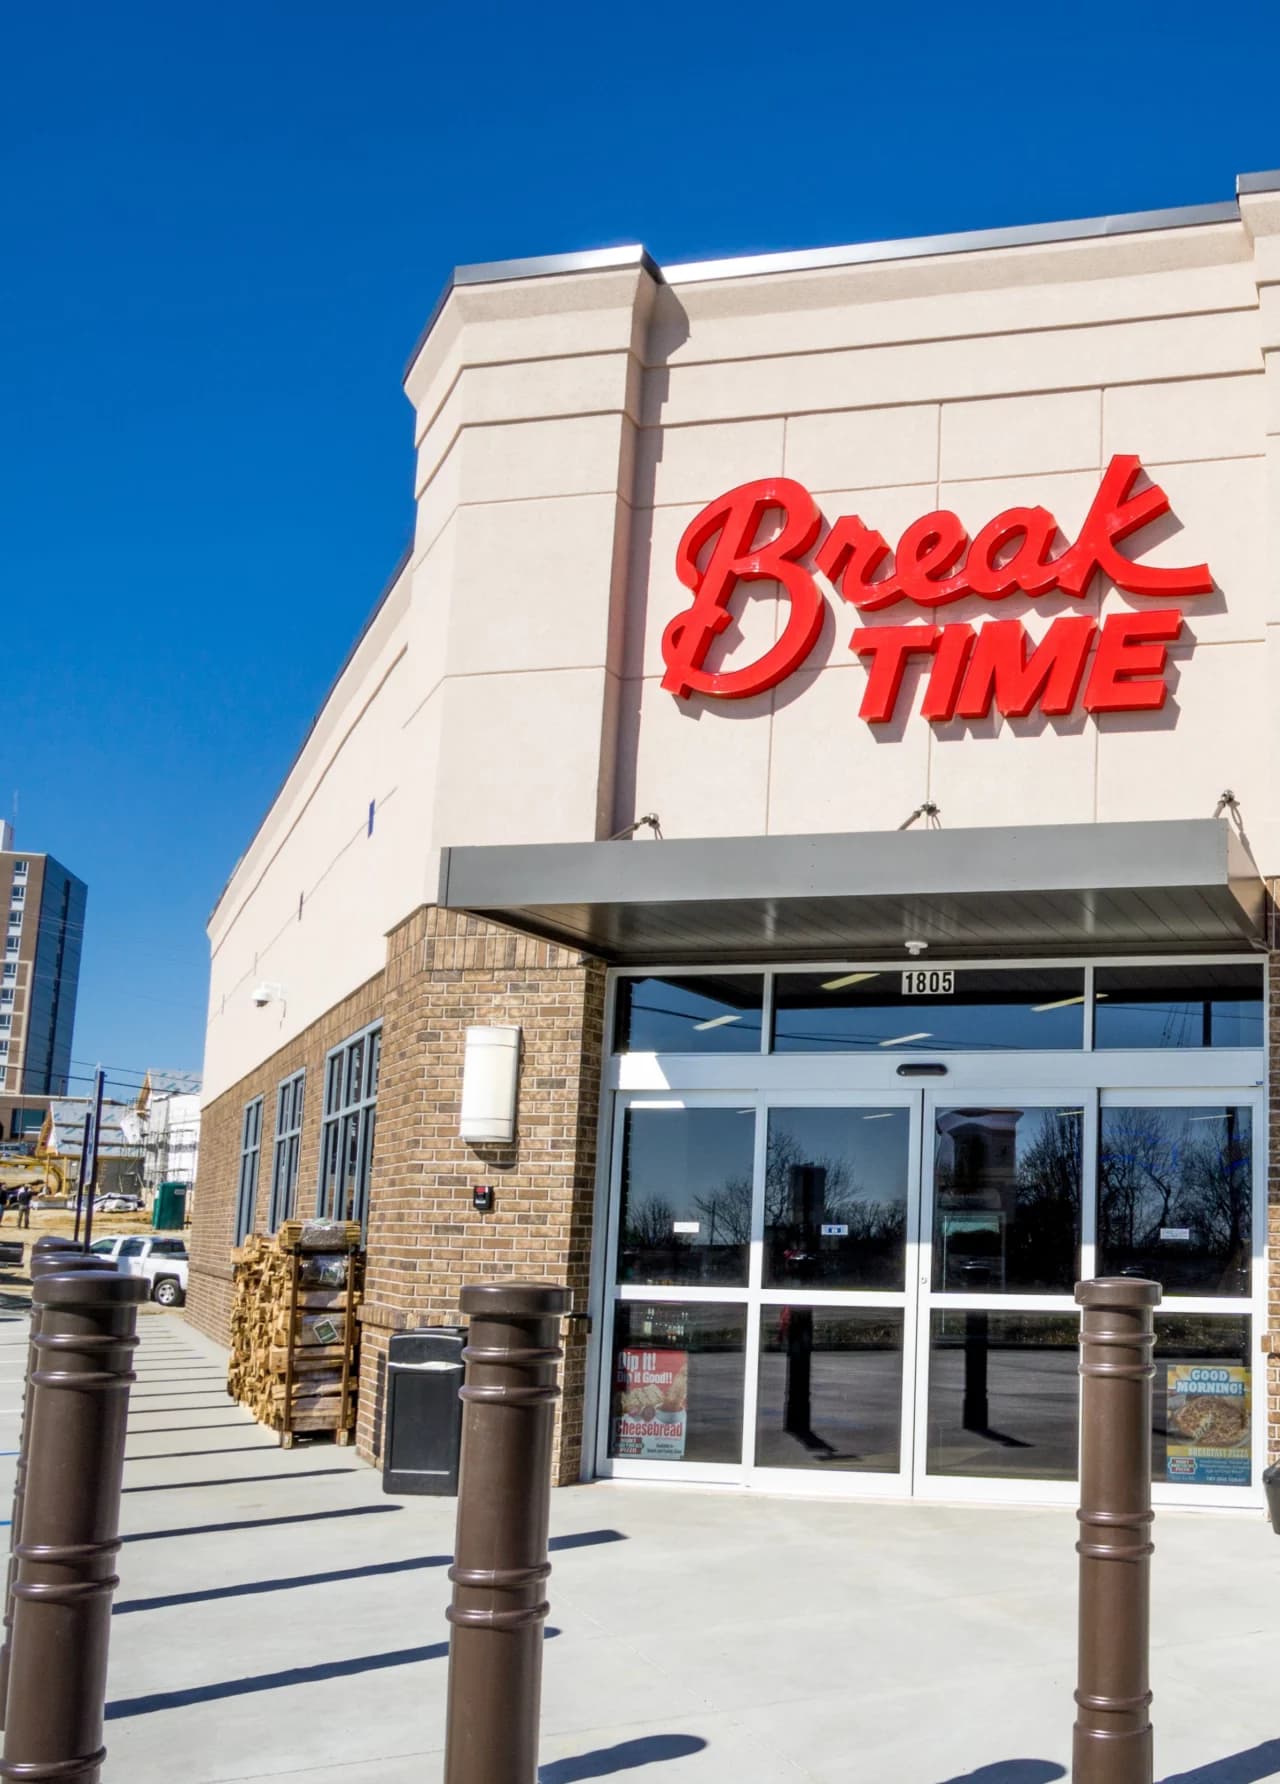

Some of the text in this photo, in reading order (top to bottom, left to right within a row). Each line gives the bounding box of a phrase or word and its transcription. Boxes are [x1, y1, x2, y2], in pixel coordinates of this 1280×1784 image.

[661, 454, 1213, 699] Break
[849, 609, 1183, 724] TIME
[905, 971, 952, 993] 1805
[1191, 1369, 1228, 1381] GOOD
[1176, 1380, 1243, 1395] MORNING!
[616, 1421, 682, 1437] Cheesebread
